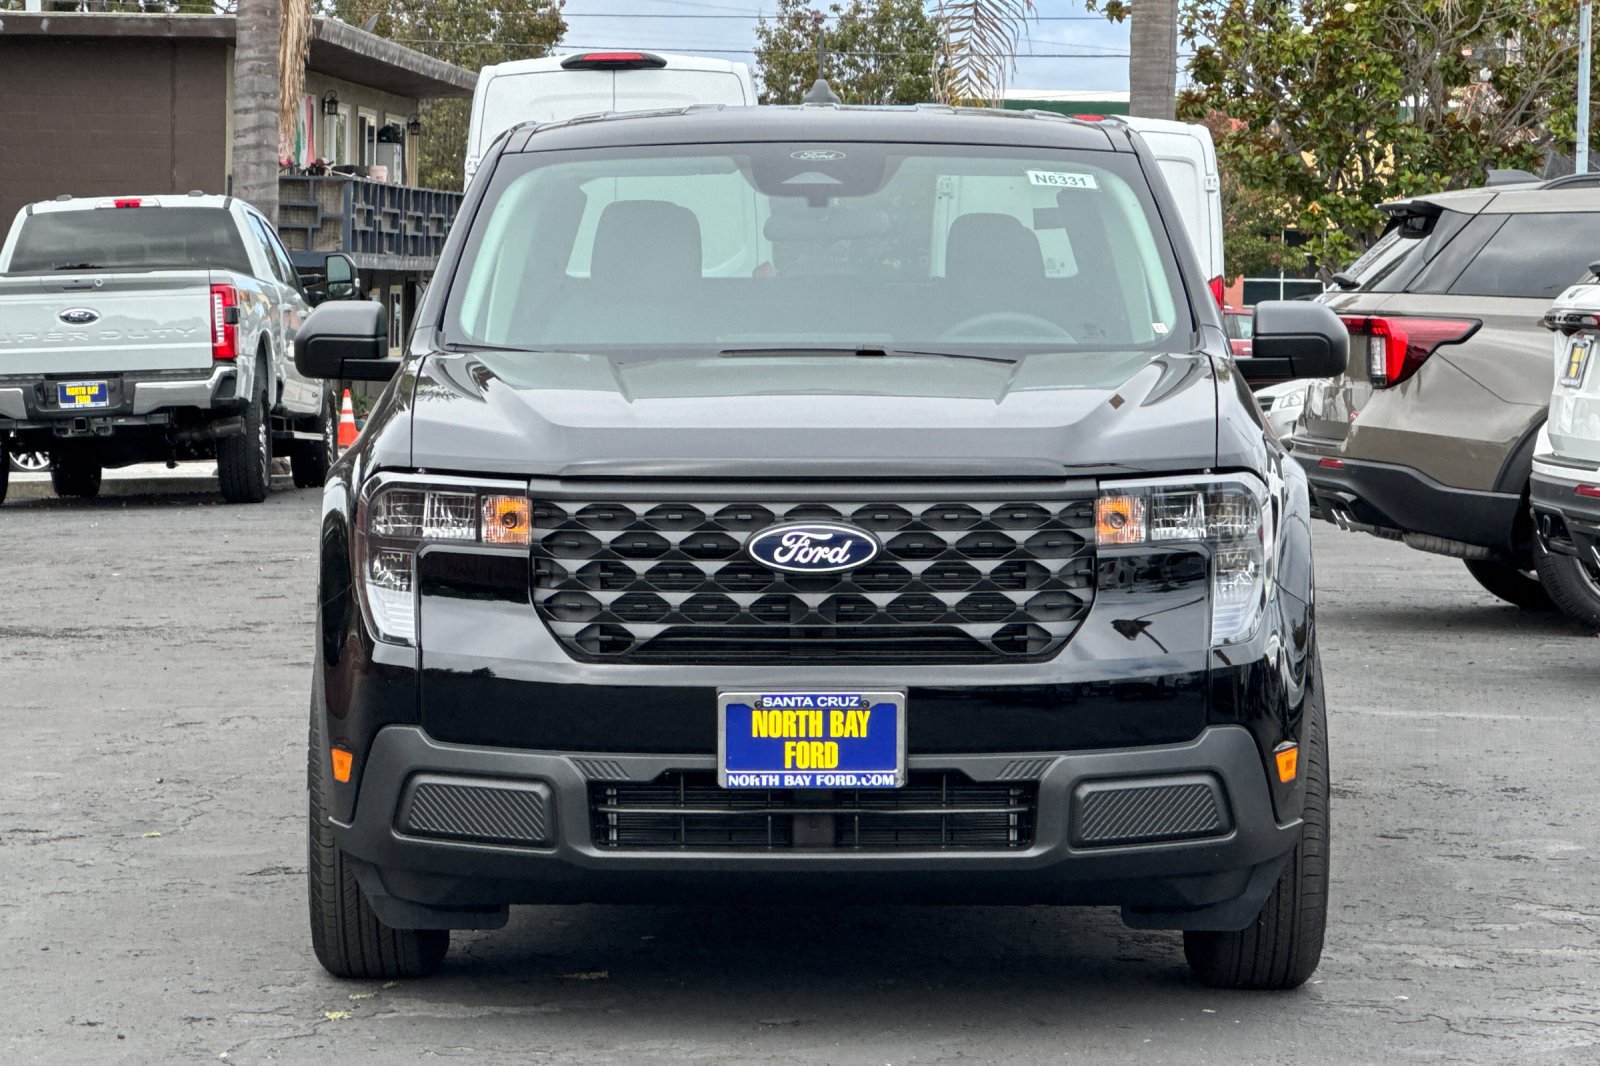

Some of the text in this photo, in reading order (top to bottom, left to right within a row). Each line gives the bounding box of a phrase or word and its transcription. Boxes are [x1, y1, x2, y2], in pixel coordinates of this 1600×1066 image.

[800, 151, 836, 159] Ford
[1034, 173, 1087, 187] N6331
[99, 327, 197, 340] DUTY
[773, 531, 853, 564] Ford
[762, 696, 859, 708] SANTA CRUZ
[752, 710, 871, 738] NORTH BAY
[784, 741, 839, 769] FORD
[728, 773, 895, 787] NORTH BAY FORD.COM
